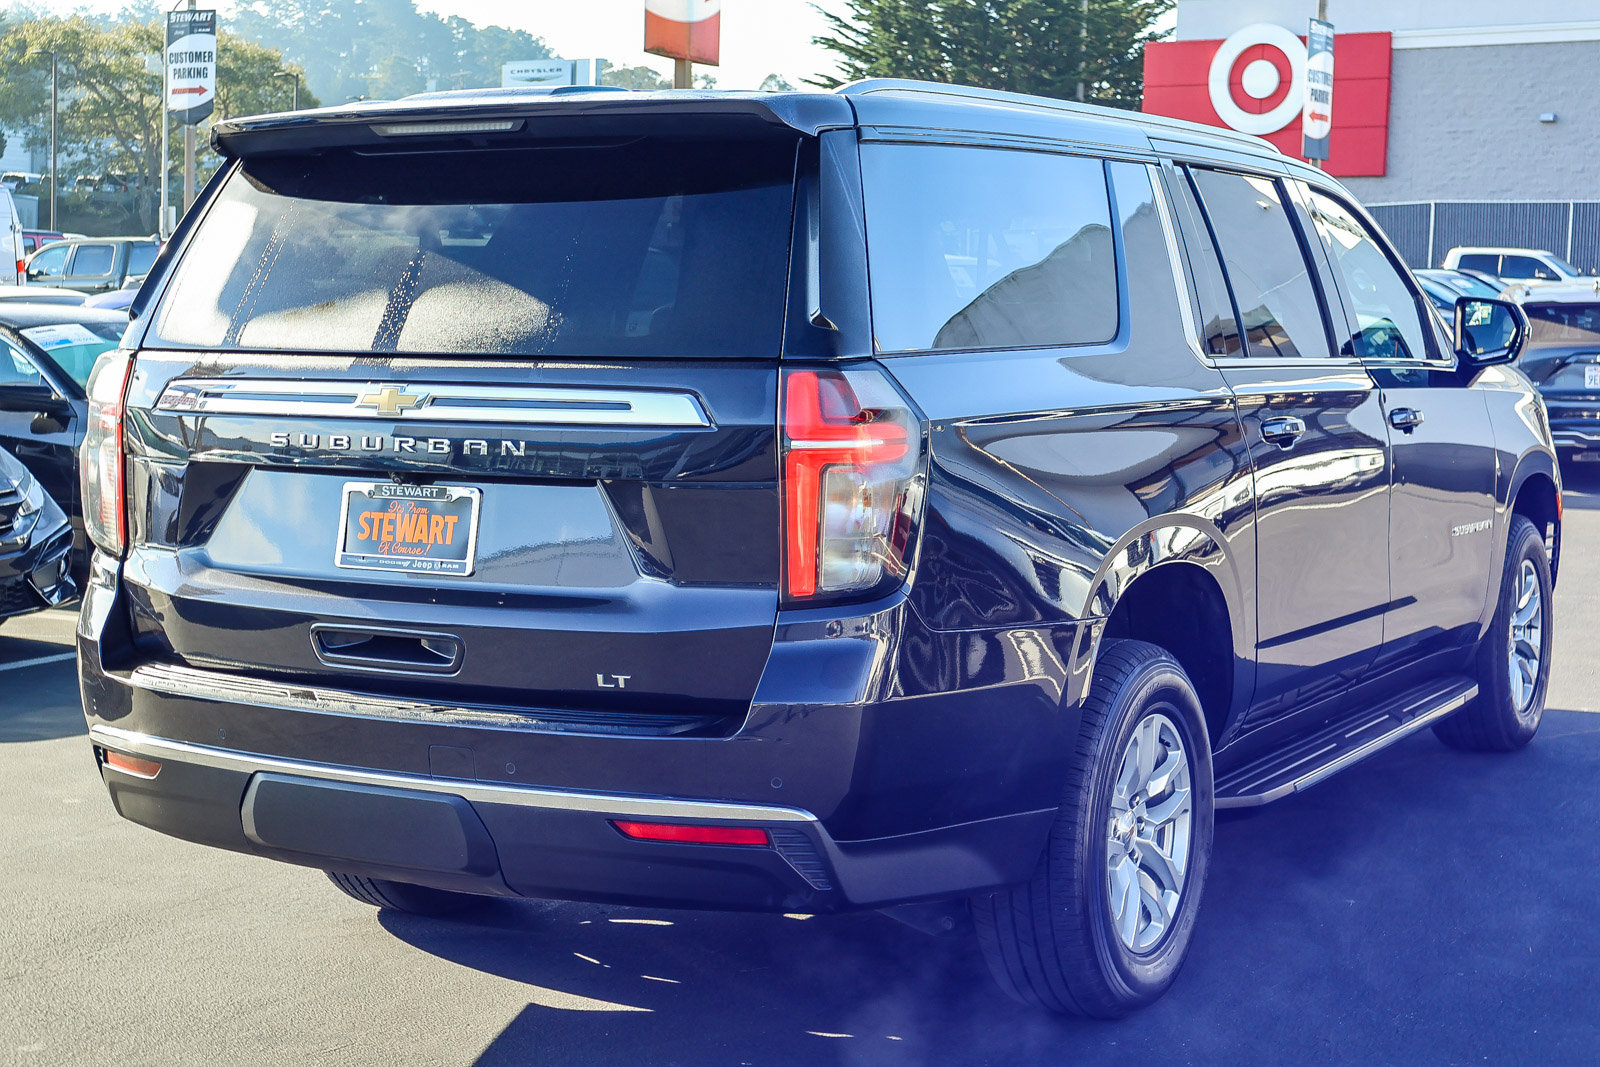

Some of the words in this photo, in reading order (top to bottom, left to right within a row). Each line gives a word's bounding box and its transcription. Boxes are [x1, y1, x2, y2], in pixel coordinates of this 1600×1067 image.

[170, 12, 214, 23] STEWART
[169, 51, 214, 64] CUSTOMER
[173, 67, 209, 79] PARKING
[269, 432, 525, 456] SUBURBAN
[382, 486, 439, 498] STEWART
[406, 502, 429, 514] From
[357, 510, 459, 545] STEWART
[378, 542, 391, 555] Of
[412, 560, 432, 570] Jeep
[596, 673, 632, 688] LT
